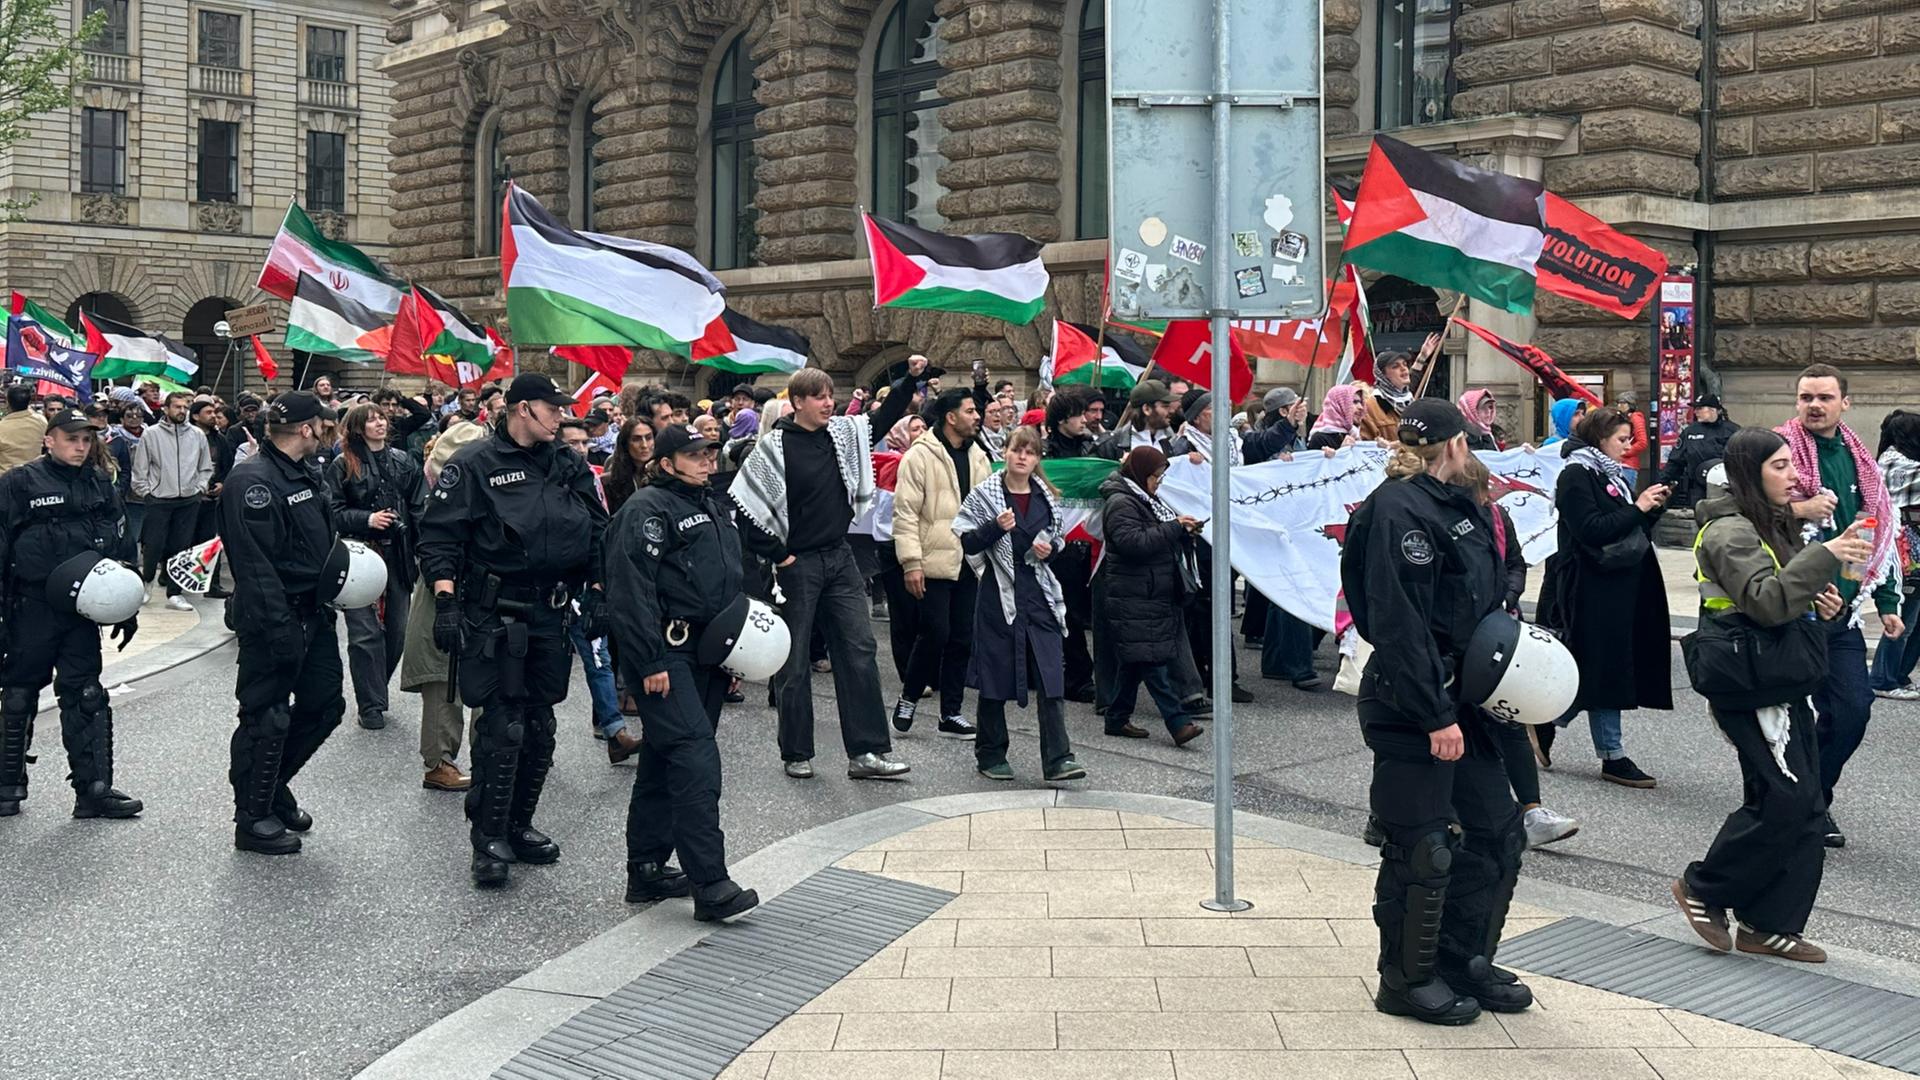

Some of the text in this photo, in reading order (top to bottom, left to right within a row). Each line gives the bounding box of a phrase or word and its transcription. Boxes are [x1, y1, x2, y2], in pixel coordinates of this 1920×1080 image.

[231, 316, 271, 333] Genozid!
[489, 471, 526, 487] POLIZEI
[30, 495, 64, 509] POLIZEI
[754, 612, 775, 633] 33
[1492, 699, 1520, 720] 33
